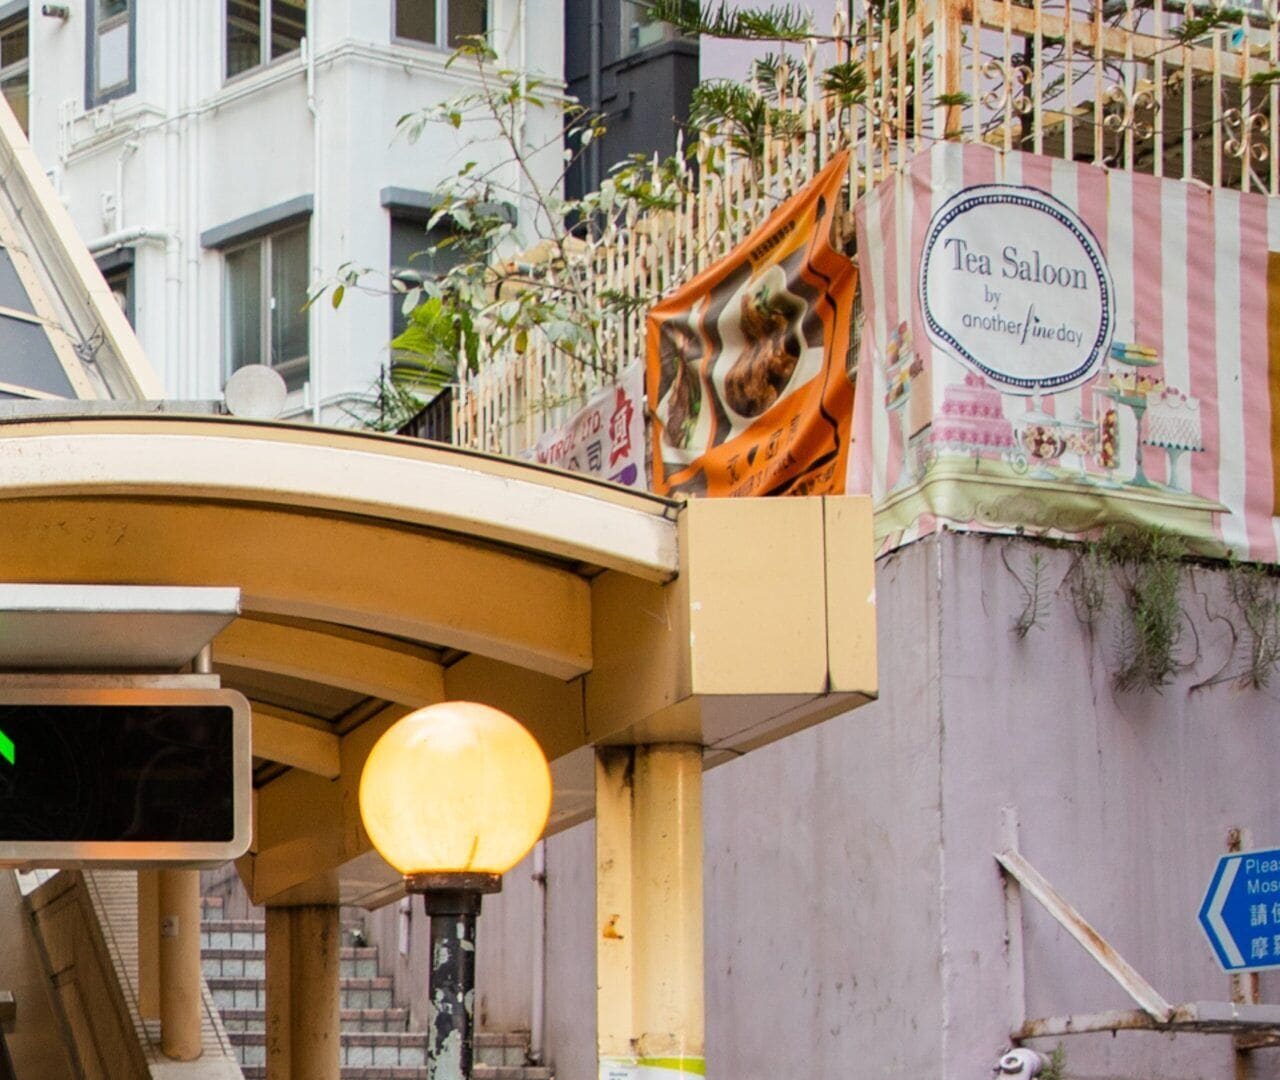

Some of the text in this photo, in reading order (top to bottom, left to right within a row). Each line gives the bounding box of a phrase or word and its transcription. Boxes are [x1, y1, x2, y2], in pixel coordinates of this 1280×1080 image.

[944, 238, 1088, 290] Tea Saloon
[984, 284, 1002, 310] by
[1245, 859, 1280, 875] Plea
[1247, 879, 1280, 895] Mos
